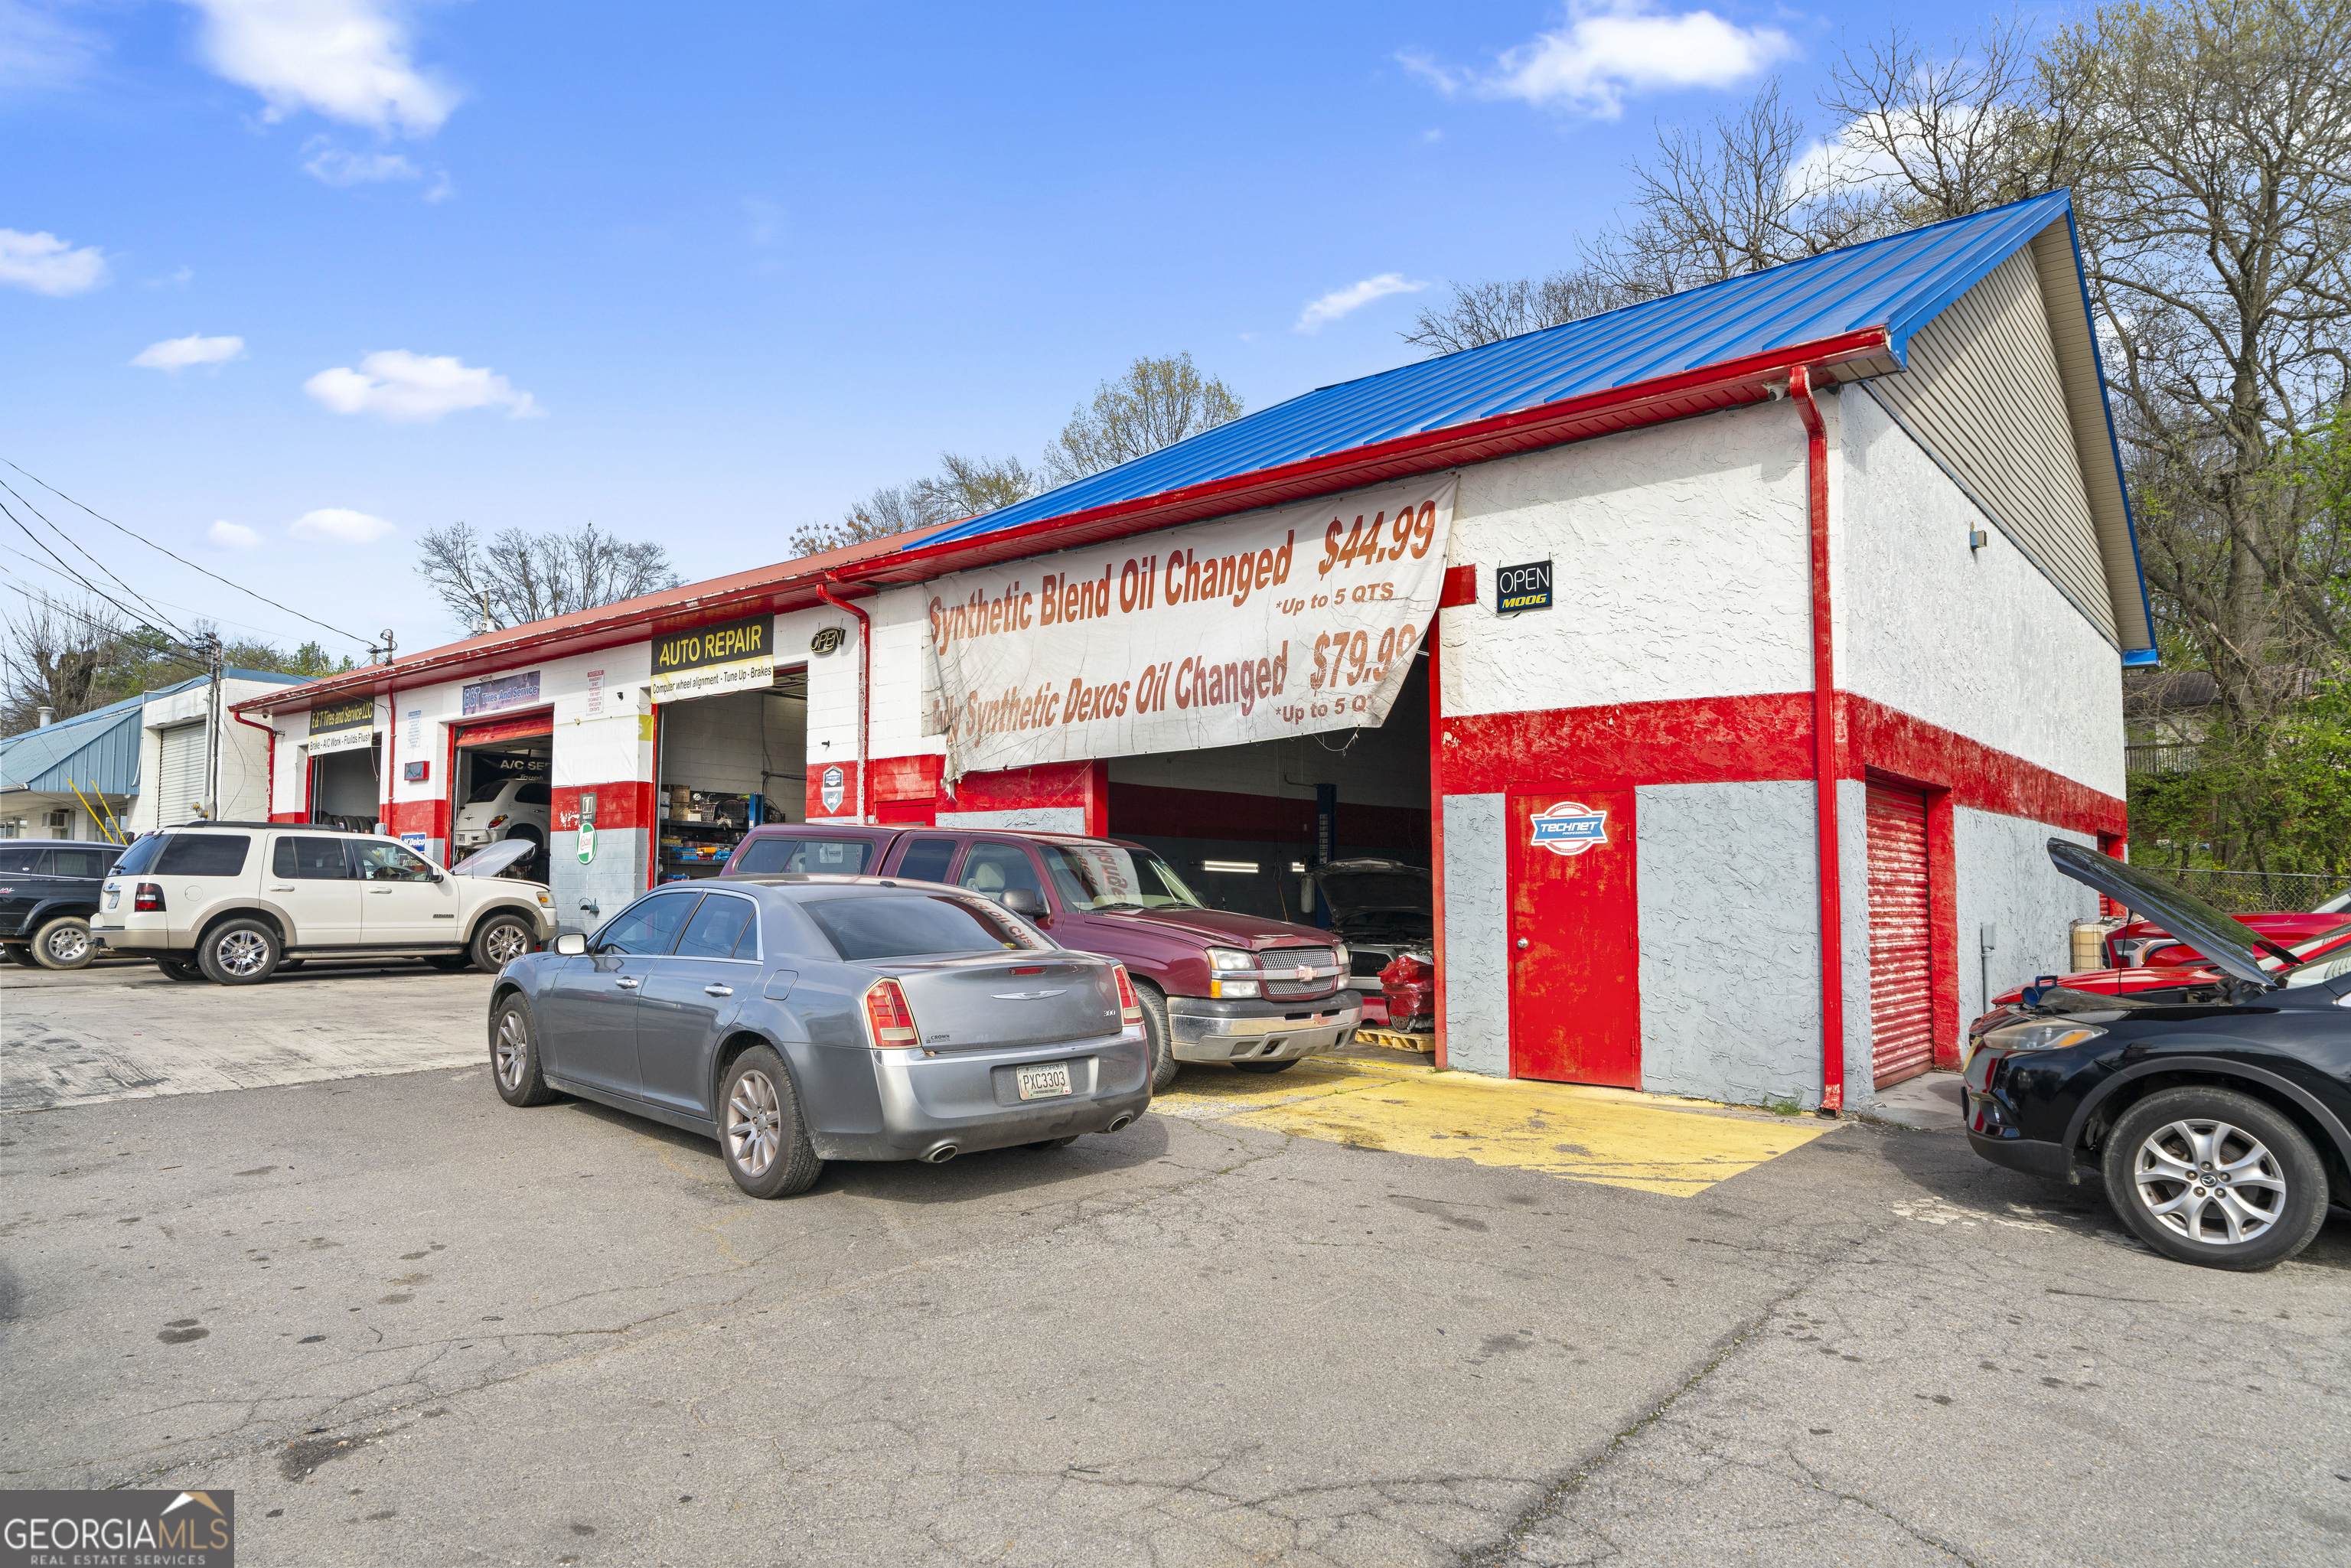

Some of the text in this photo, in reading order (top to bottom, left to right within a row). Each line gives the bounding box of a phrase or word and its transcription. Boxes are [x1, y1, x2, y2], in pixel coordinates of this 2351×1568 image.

[929, 500, 1436, 656] Synthetic Blend Oil Changed $44.99
[1500, 566, 1549, 593] OPEN
[1311, 593, 1328, 608] to
[1334, 588, 1345, 605] 5
[1352, 582, 1394, 603] QTS
[1502, 593, 1547, 608] MOOG
[660, 624, 762, 667] AUTO REPAIR
[810, 629, 843, 649] OPEN
[653, 682, 675, 695] Computer
[676, 678, 692, 689] wheel
[693, 673, 719, 689] alignment
[724, 671, 737, 683] Tune
[739, 669, 746, 681] Up
[751, 666, 771, 678] Brakes
[465, 686, 481, 708] E&T
[482, 693, 497, 704] Tires
[499, 688, 511, 700] And
[513, 683, 537, 698] Service
[966, 683, 1059, 748] Synthetic
[1062, 678, 1130, 724] Dexos
[1136, 662, 1172, 715] Oil
[1176, 640, 1288, 716] Changed
[311, 713, 315, 729] E
[320, 712, 324, 727] T
[324, 710, 334, 726] Tires
[335, 707, 344, 725] and
[344, 705, 363, 723] Service
[362, 703, 373, 719] LLC
[1310, 703, 1329, 718] to
[1336, 696, 1345, 714] 5
[310, 742, 320, 750] Brake
[331, 737, 341, 747] Work
[358, 732, 370, 743] Flush
[501, 760, 524, 769] A/C
[1023, 1071, 1066, 1090] PXC3303
[1037, 1064, 1065, 1072] GEORGIA
